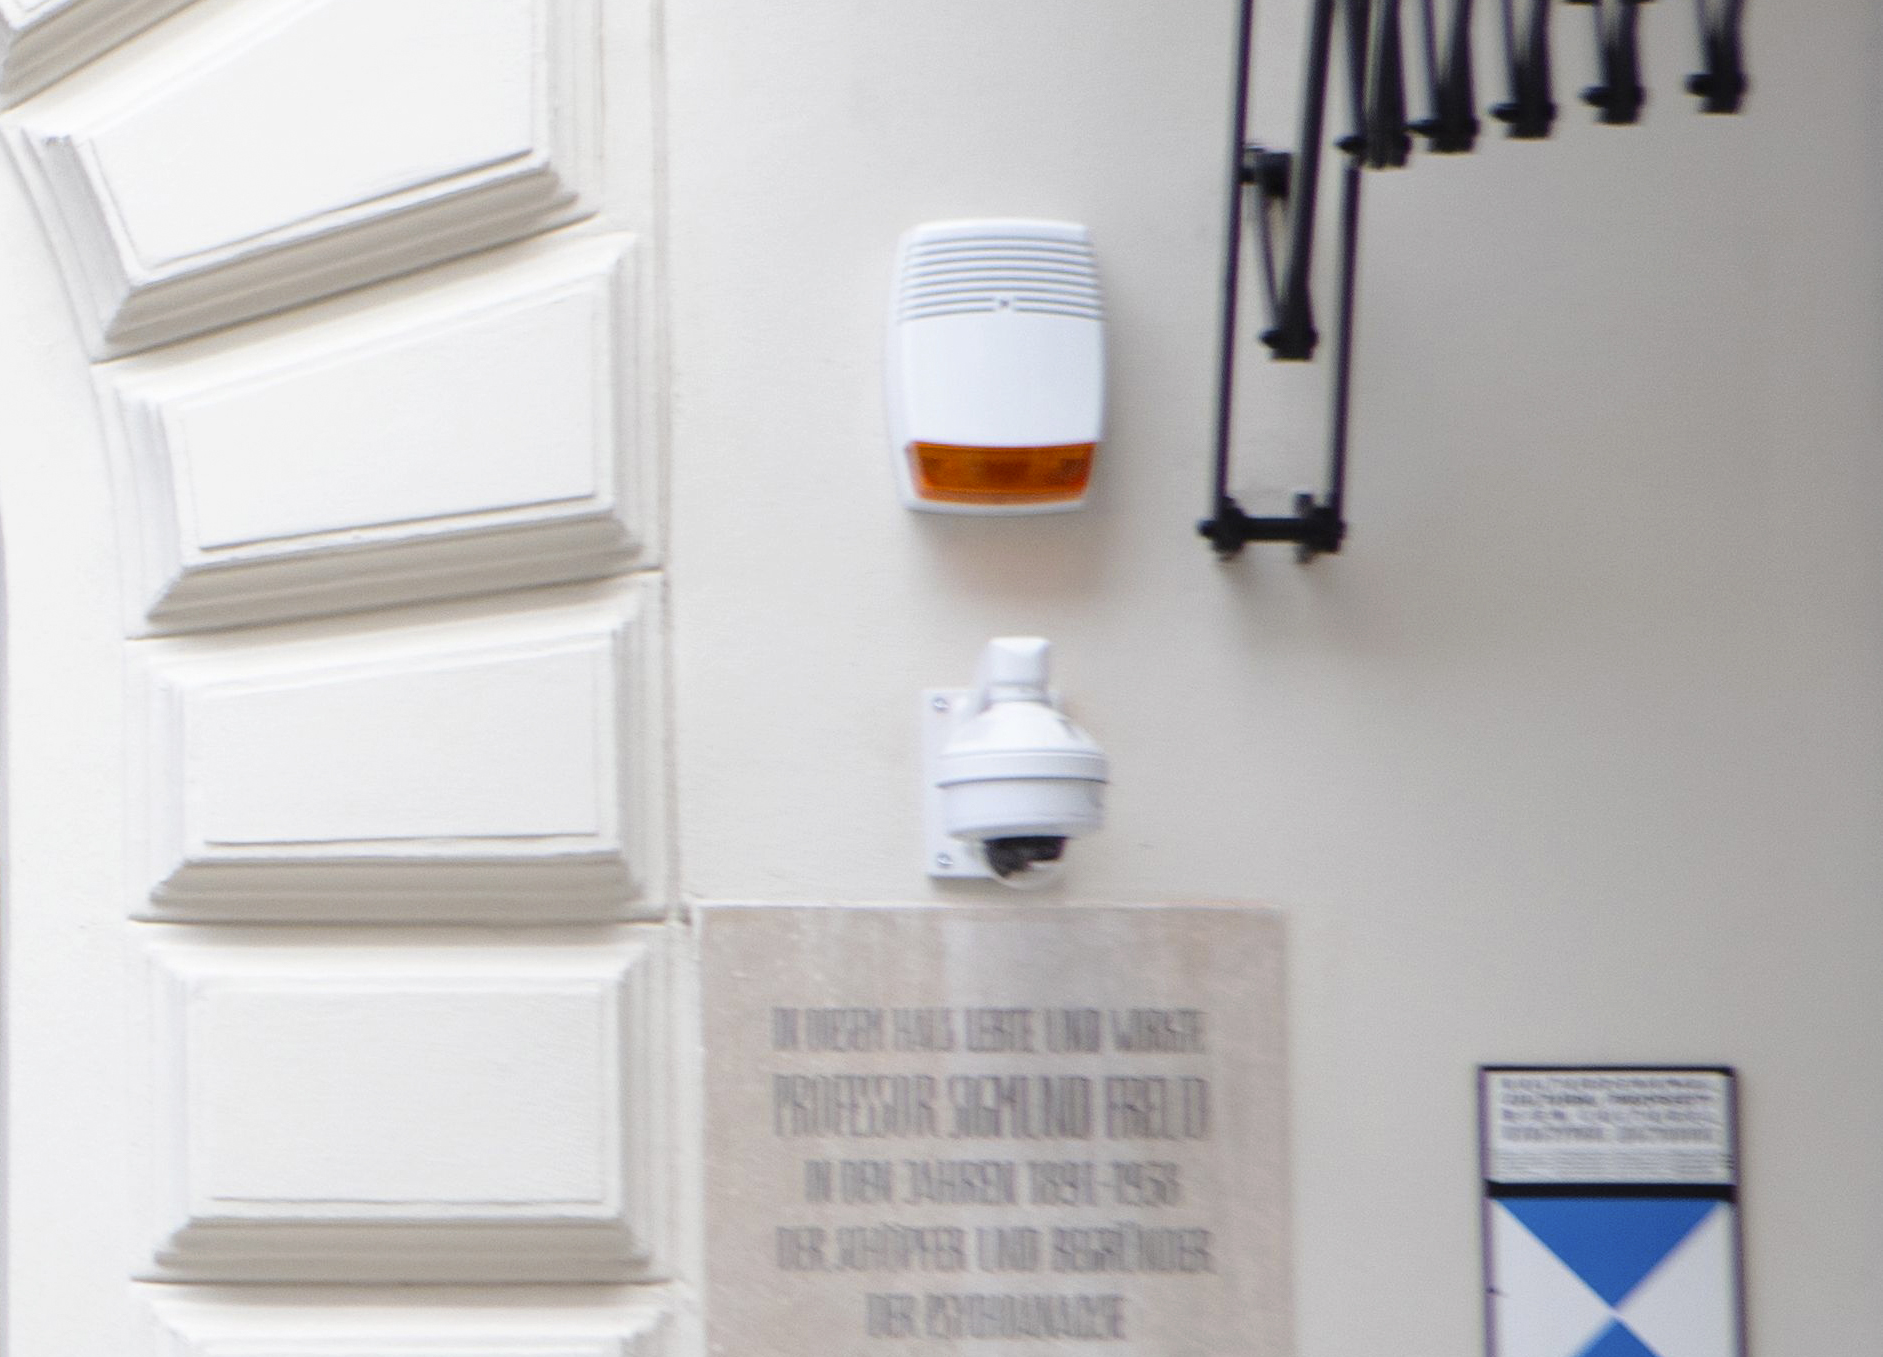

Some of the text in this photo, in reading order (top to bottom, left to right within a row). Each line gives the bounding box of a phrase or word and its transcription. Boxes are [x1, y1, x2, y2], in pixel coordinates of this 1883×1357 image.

[772, 1074, 1210, 1138] PROFESSOR SIGMUND FREUD
